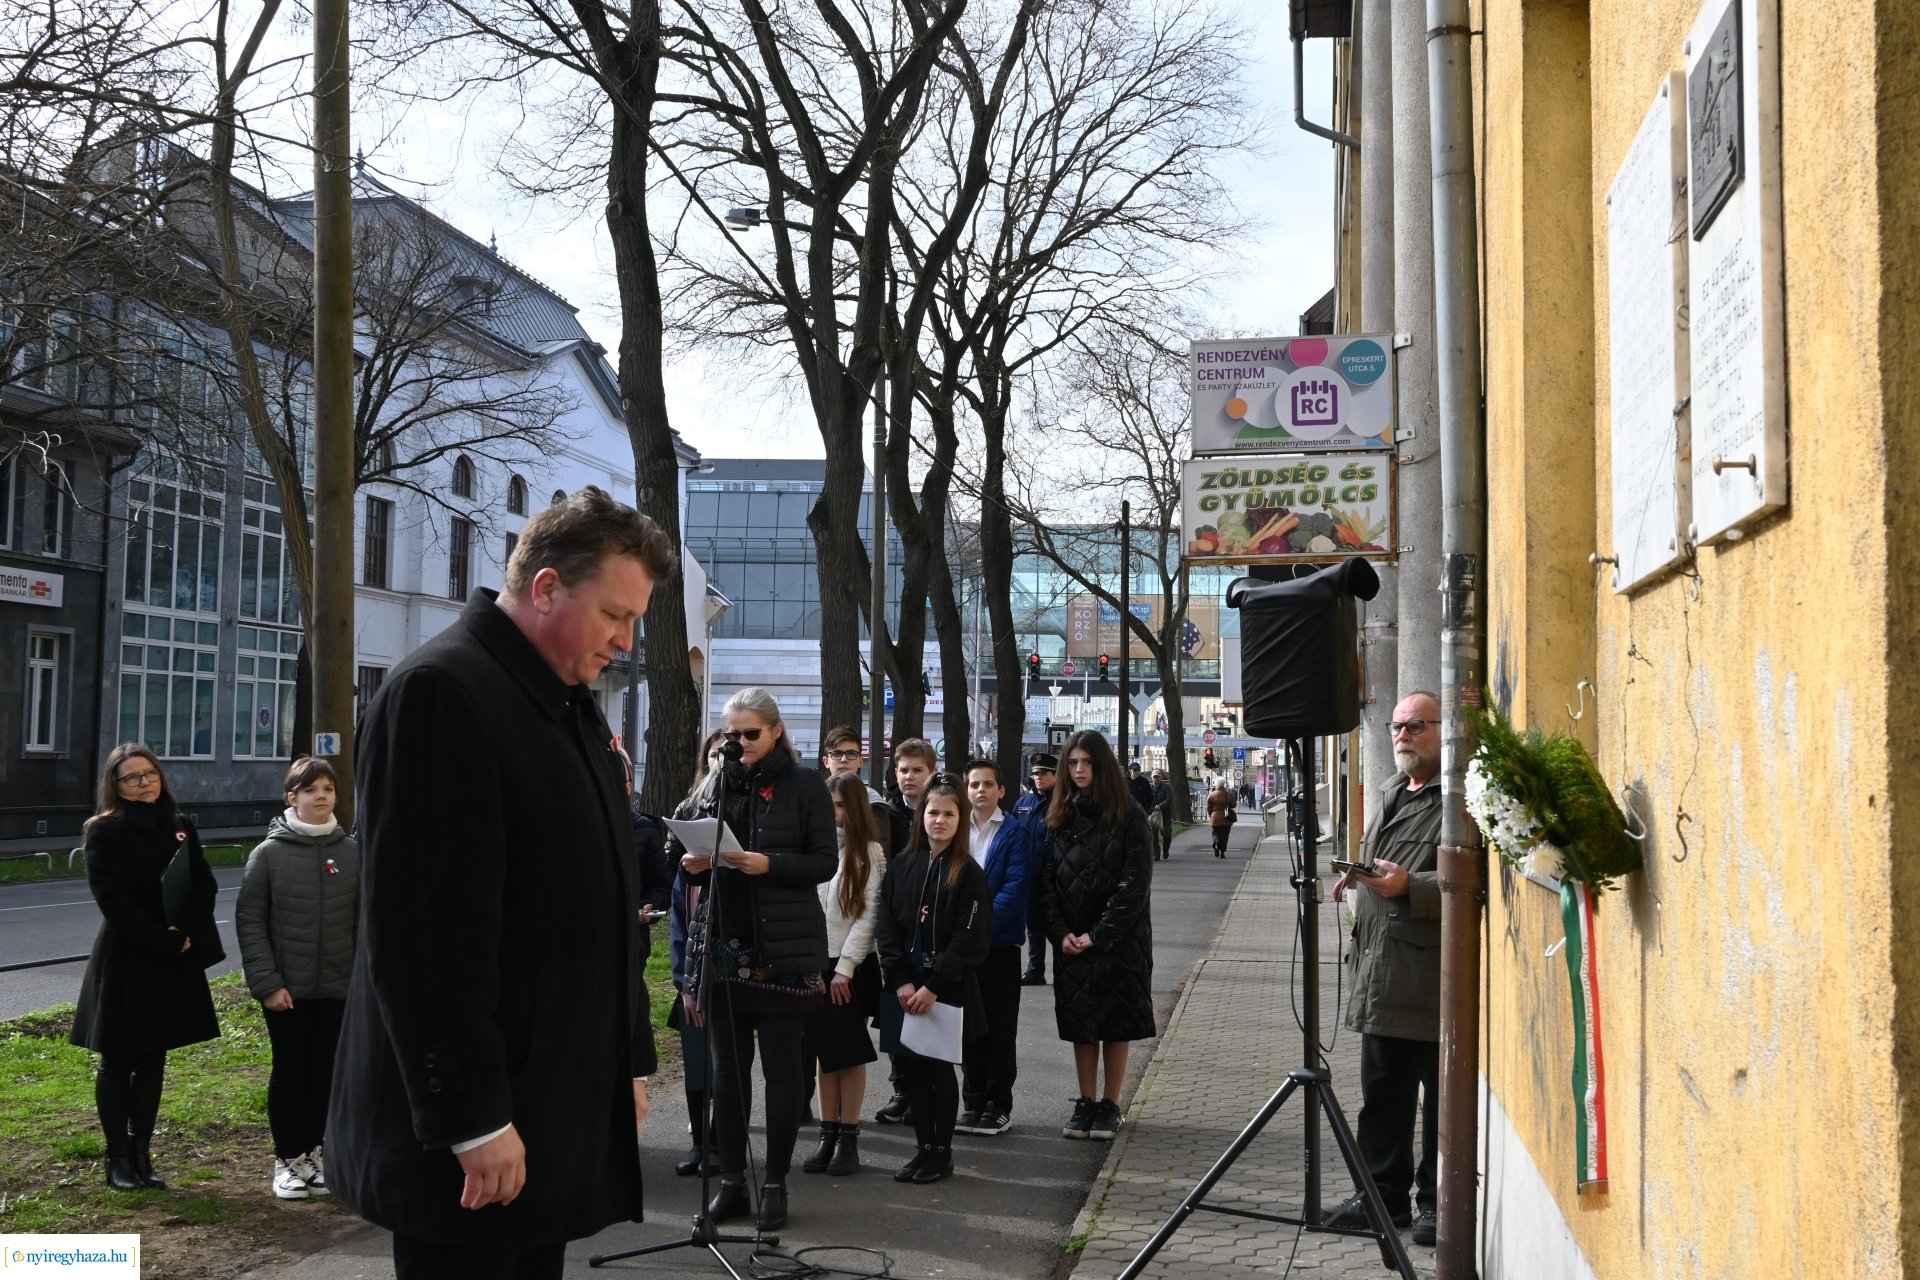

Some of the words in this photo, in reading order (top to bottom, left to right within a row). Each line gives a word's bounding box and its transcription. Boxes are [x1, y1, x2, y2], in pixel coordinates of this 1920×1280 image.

[1197, 347, 1288, 363] RENDEZVÉNY
[1342, 354, 1384, 364] EPRESKERT
[1197, 367, 1265, 381] CENTRUM
[1208, 383, 1232, 391] PARTY
[1233, 381, 1276, 390] SZAKÜZLET
[1301, 397, 1328, 414] RC
[1234, 438, 1351, 448] www.rendezvenycentrum.com
[1197, 461, 1329, 491] ZÖLDSÉG
[1338, 462, 1376, 481] és
[1198, 483, 1378, 512] GYÜMÖLCS
[1203, 733, 1215, 741] STOP
[1236, 751, 1242, 759] P
